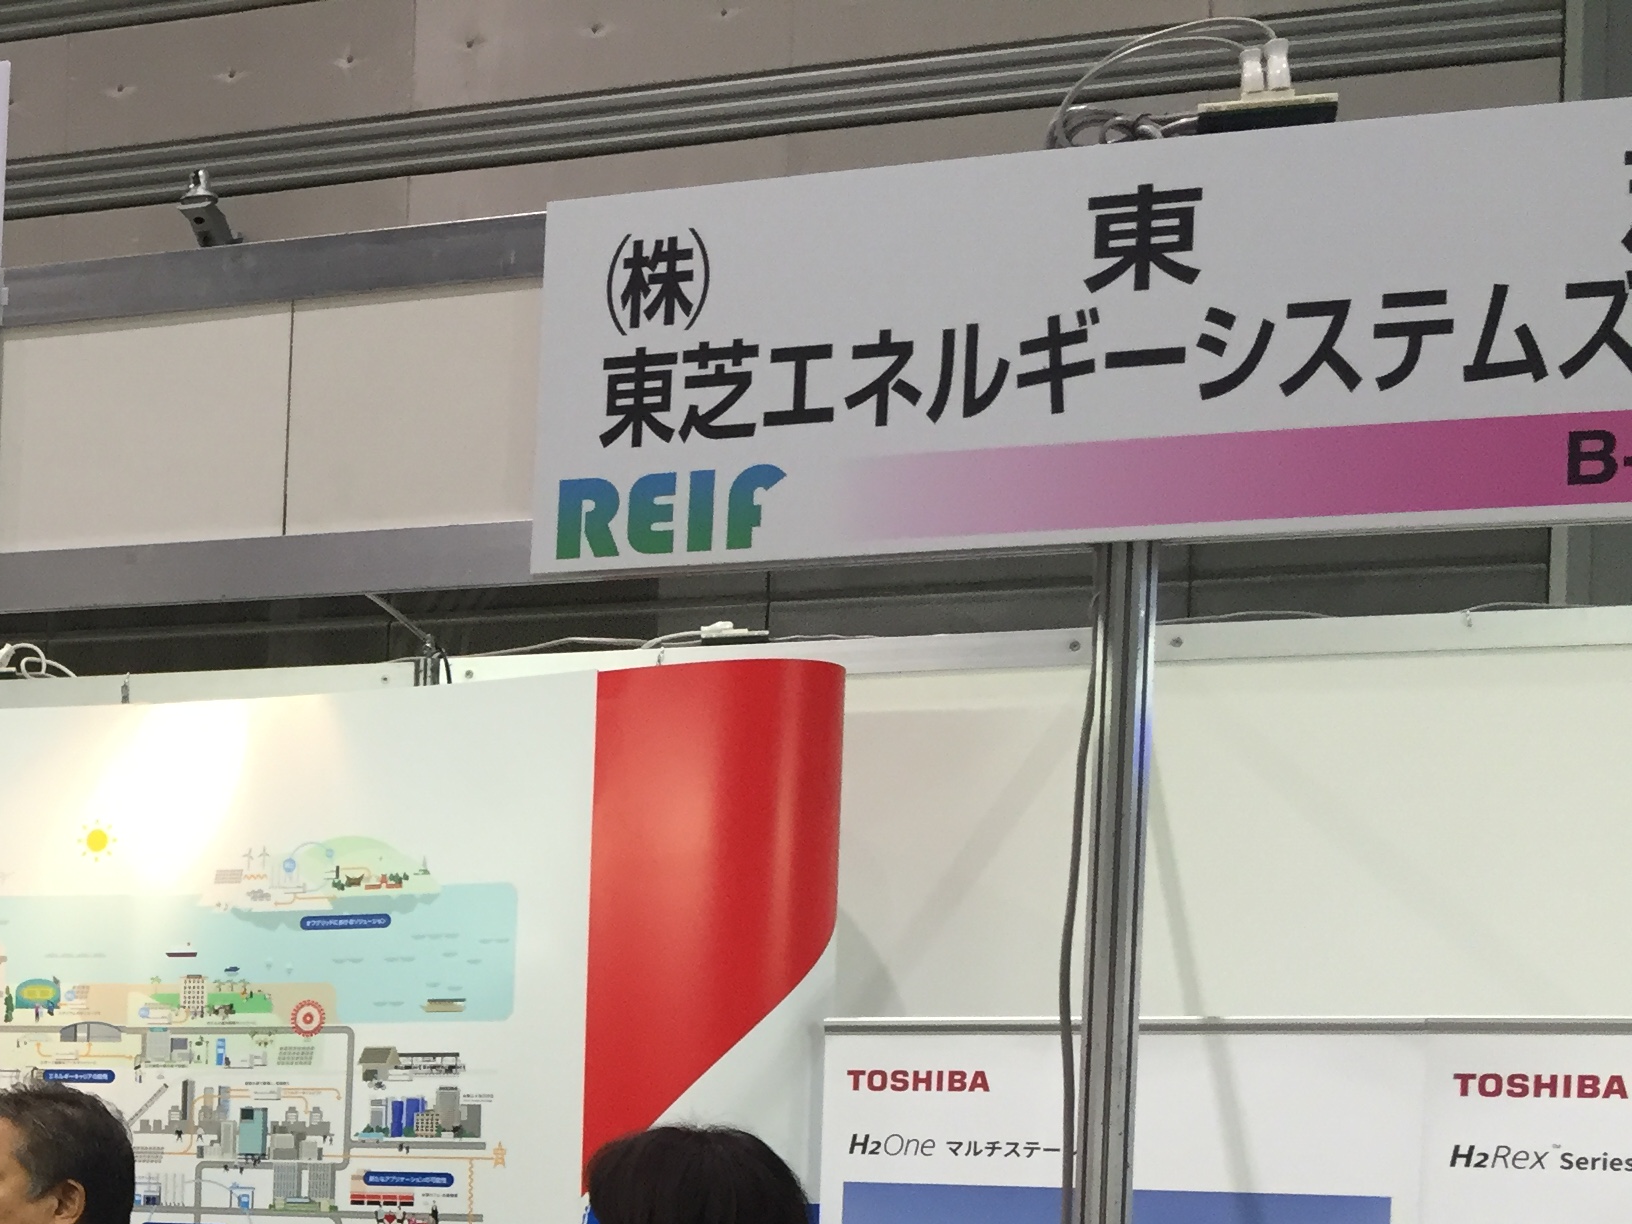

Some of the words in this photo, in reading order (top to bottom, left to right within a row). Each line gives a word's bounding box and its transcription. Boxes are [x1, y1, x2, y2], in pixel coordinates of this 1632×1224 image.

[598, 270, 1632, 448] 東芝エネルギーシステムズ
[555, 462, 788, 561] REIF
[847, 1070, 990, 1092] TOSHIBA
[1453, 1073, 1628, 1099] TOSHIBA
[946, 1142, 1076, 1159] マルチステー
[1560, 1152, 1632, 1171] Series
